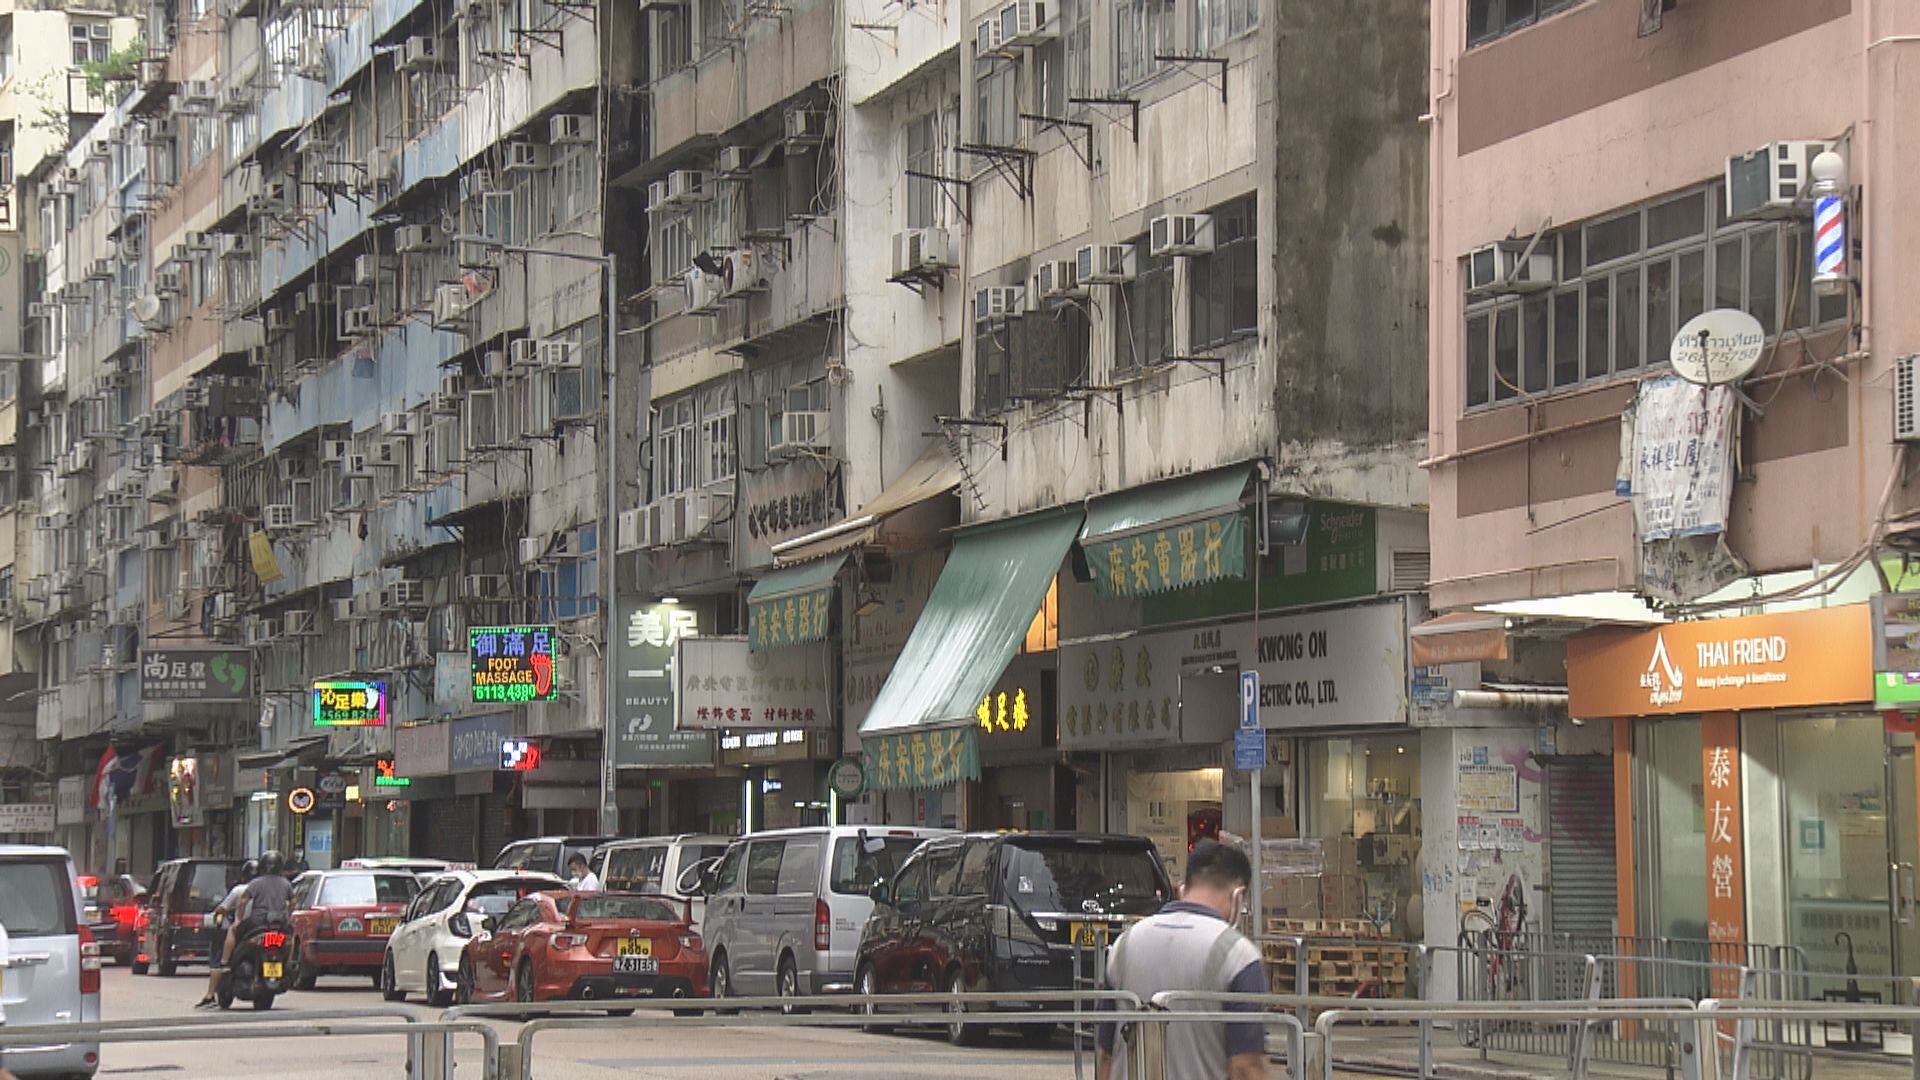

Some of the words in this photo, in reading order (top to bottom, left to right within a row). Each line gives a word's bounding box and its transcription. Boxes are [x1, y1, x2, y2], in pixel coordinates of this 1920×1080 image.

[1109, 521, 1222, 595] 廣安電器行
[476, 632, 551, 657] 御滿足
[1259, 633, 1303, 663] KWONG
[1309, 631, 1327, 657] ON
[1696, 640, 1728, 668] THAI
[1733, 636, 1786, 665] FRIEND
[476, 670, 532, 685] MASSAGE
[488, 657, 519, 671] FOOT
[625, 697, 669, 705] BEAUTY
[1244, 677, 1254, 722] P
[1318, 679, 1338, 703] LTD.
[1709, 746, 1733, 899] 泰友營
